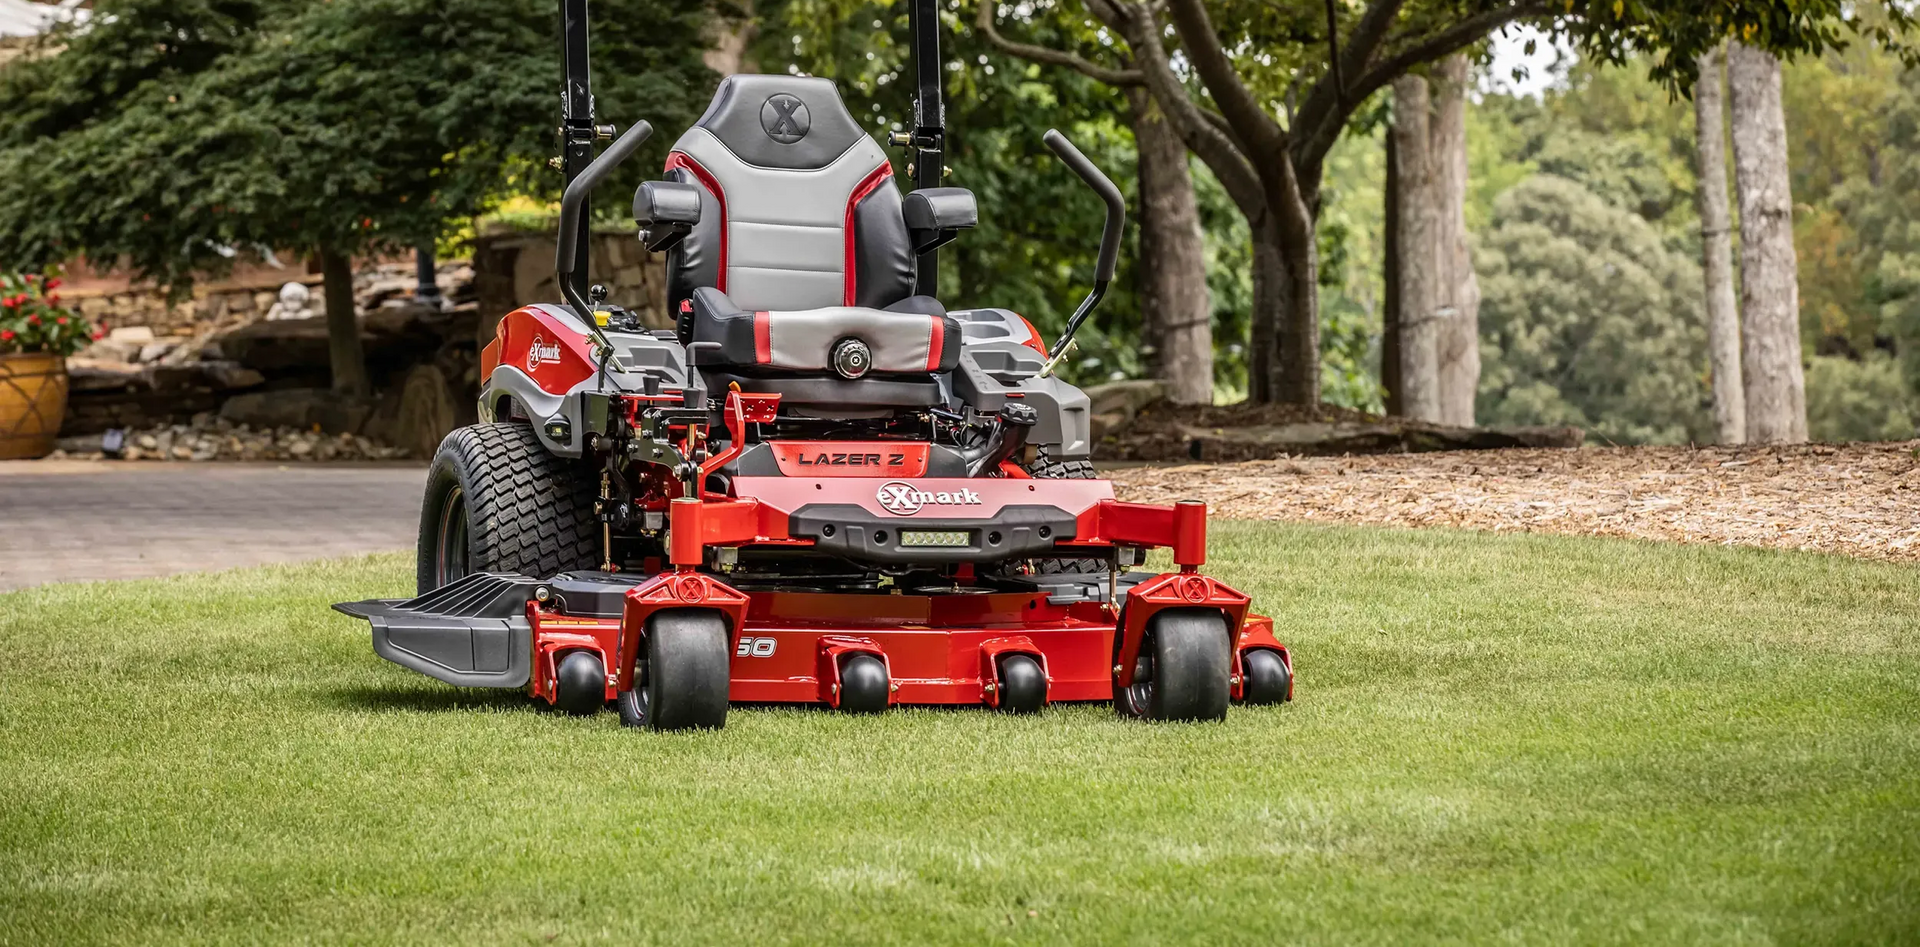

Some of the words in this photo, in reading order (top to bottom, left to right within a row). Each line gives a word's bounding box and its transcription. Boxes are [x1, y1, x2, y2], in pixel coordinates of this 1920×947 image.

[766, 98, 804, 137] X
[798, 453, 881, 466] LAZER
[887, 453, 904, 466] Z
[876, 486, 982, 511] eXmark
